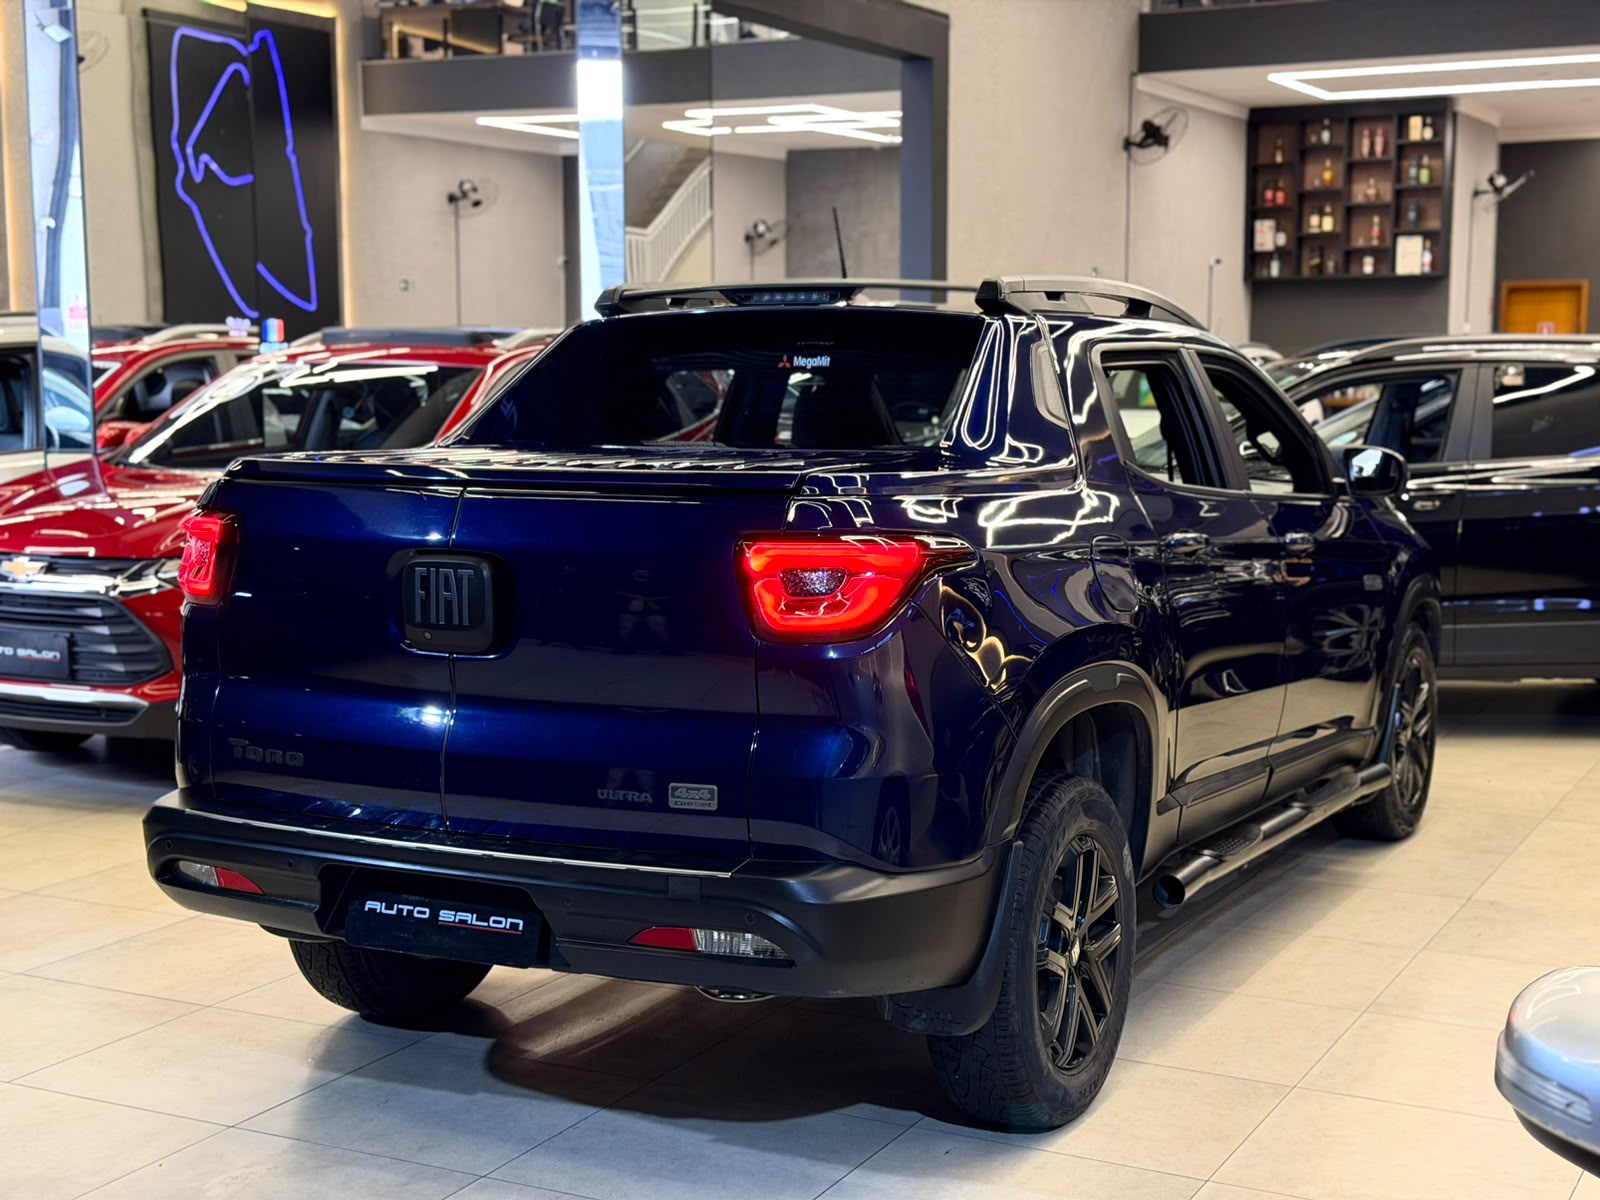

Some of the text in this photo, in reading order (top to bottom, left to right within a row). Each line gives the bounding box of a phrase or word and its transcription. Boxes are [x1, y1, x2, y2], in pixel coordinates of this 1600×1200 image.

[793, 355, 831, 369] MegaMit
[415, 567, 474, 626] FIAT
[597, 788, 653, 804] ULTRA
[674, 787, 712, 800] 4x4
[364, 900, 524, 931] AUTO SALON
